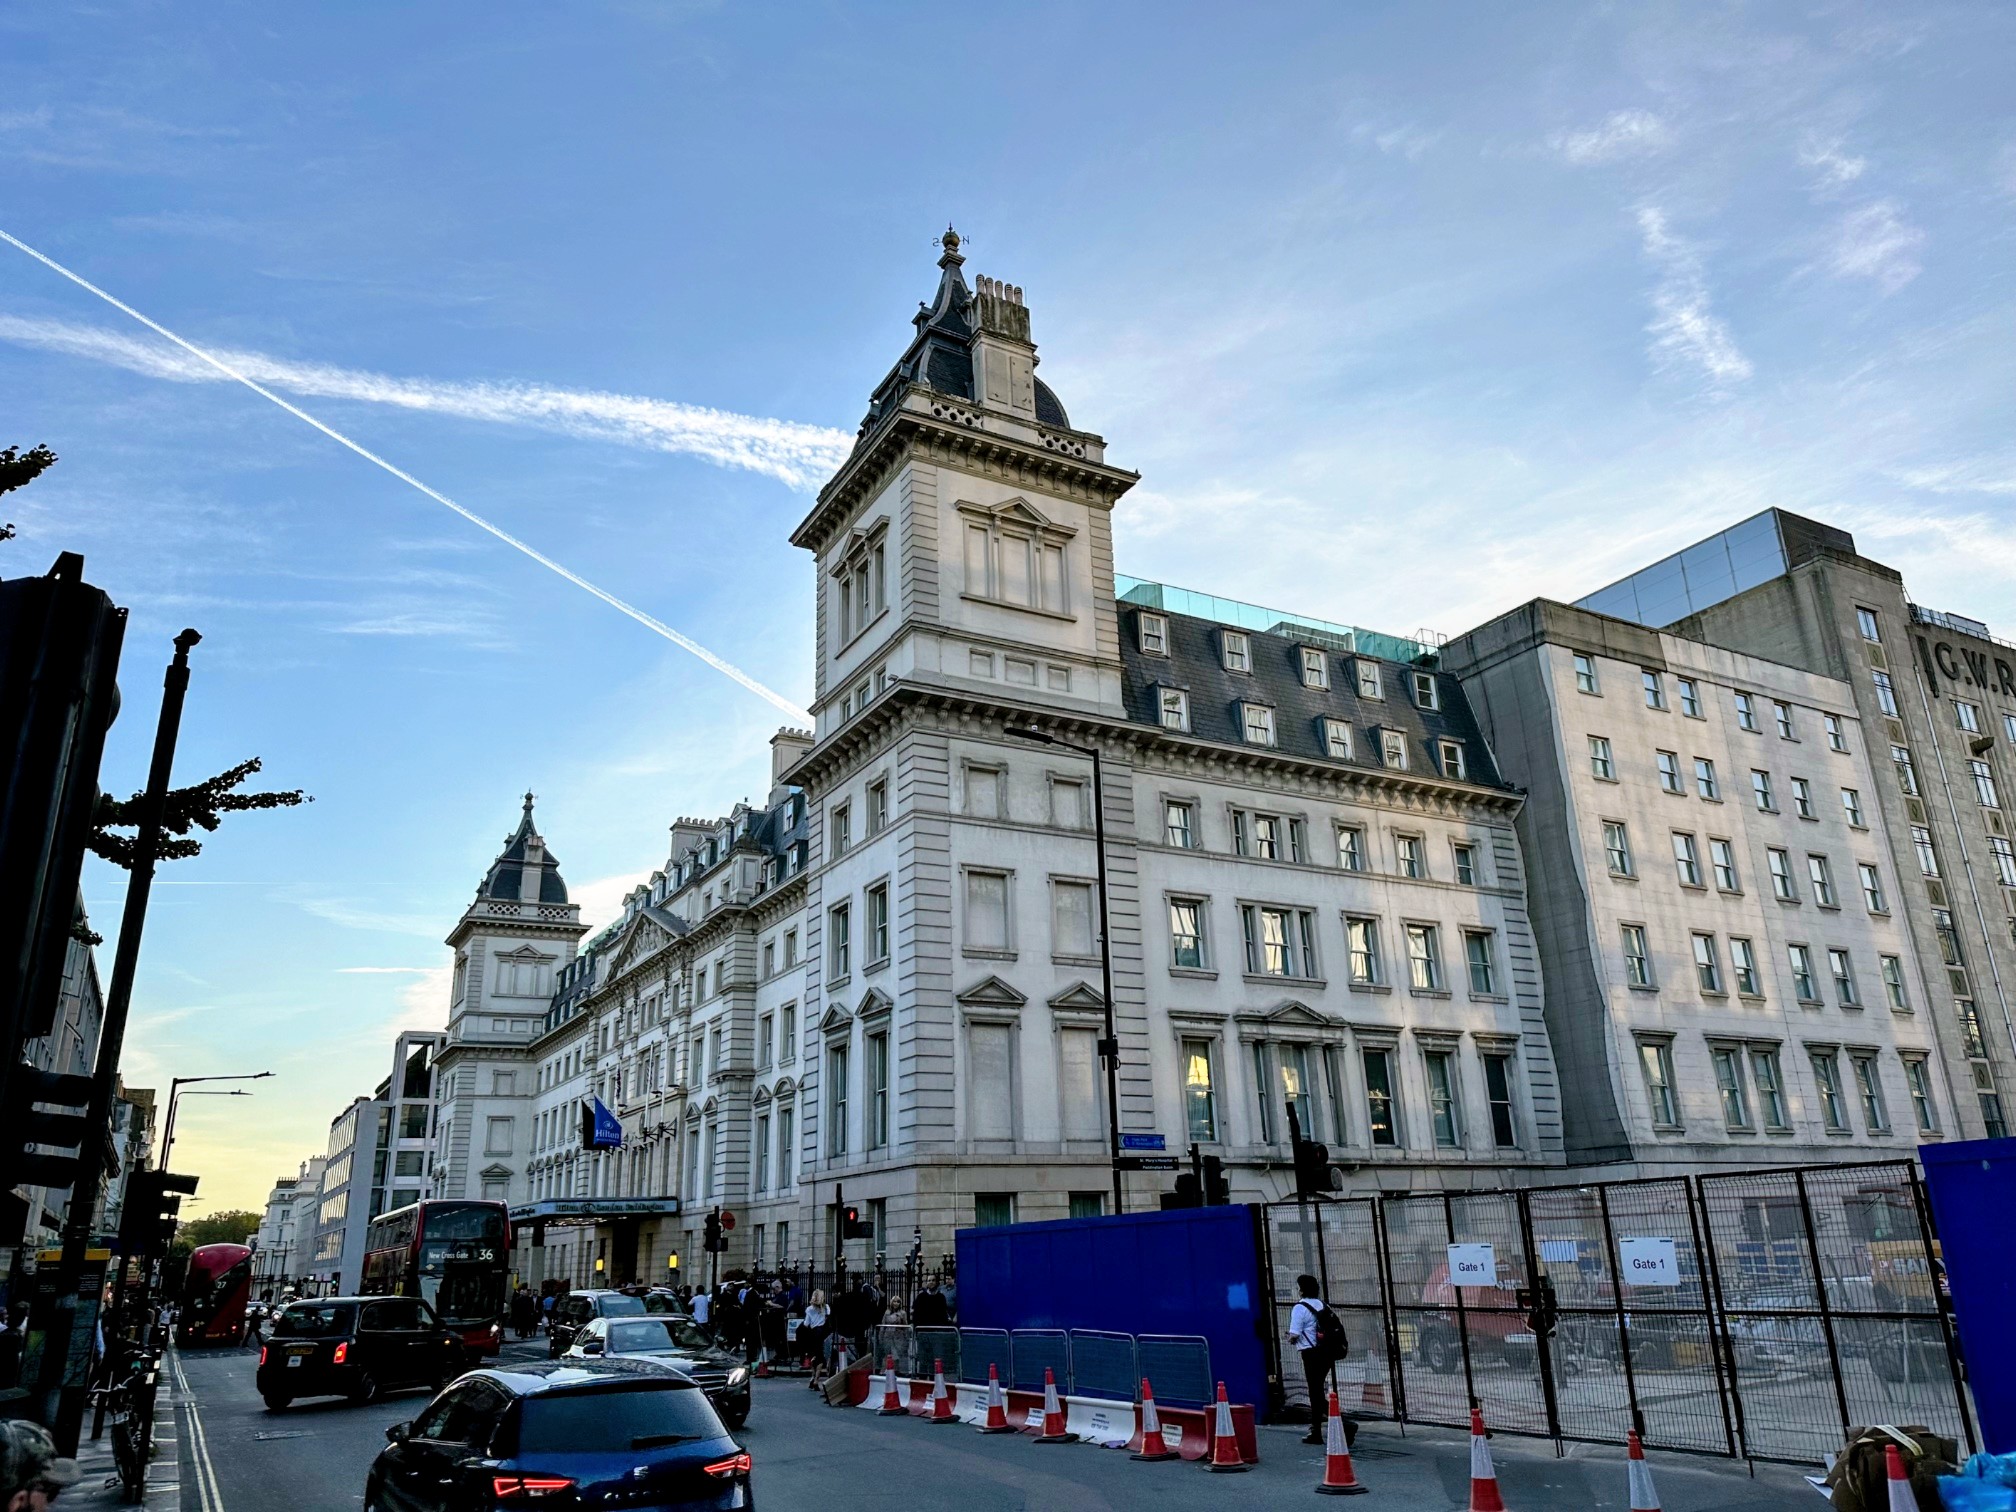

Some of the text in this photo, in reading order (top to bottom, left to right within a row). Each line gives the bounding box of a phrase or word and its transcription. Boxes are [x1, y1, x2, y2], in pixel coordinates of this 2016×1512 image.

[595, 1129, 620, 1139] Hilton
[556, 1202, 579, 1212] Hilton
[441, 1251, 455, 1259] Cross
[456, 1251, 469, 1259] Gate
[479, 1248, 493, 1260] 36
[1458, 1262, 1478, 1272] Gate
[1480, 1262, 1485, 1271] 1
[1633, 1258, 1665, 1269] Gate 1
[217, 1281, 227, 1289] 27
